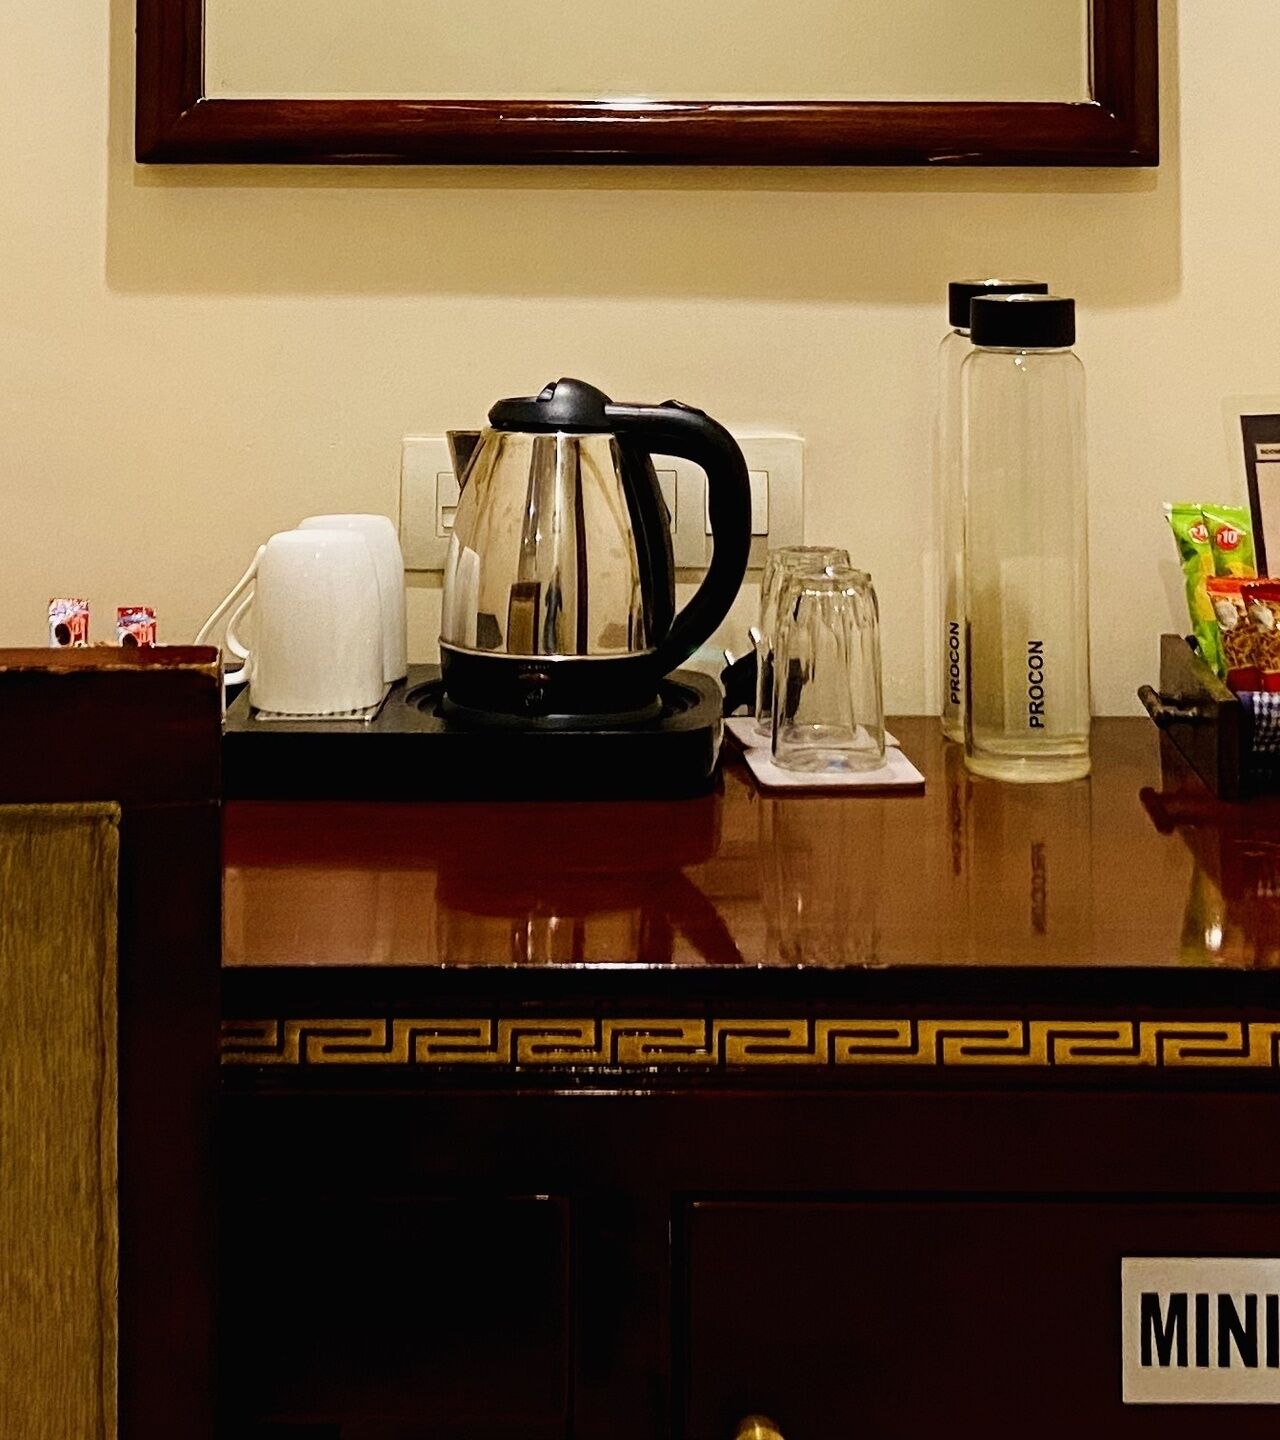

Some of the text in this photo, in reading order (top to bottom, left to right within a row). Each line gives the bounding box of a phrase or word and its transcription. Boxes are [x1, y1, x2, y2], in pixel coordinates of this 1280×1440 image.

[948, 621, 961, 705] PROCON
[1027, 640, 1045, 729] PROCON
[1140, 1292, 1280, 1368] MINI
